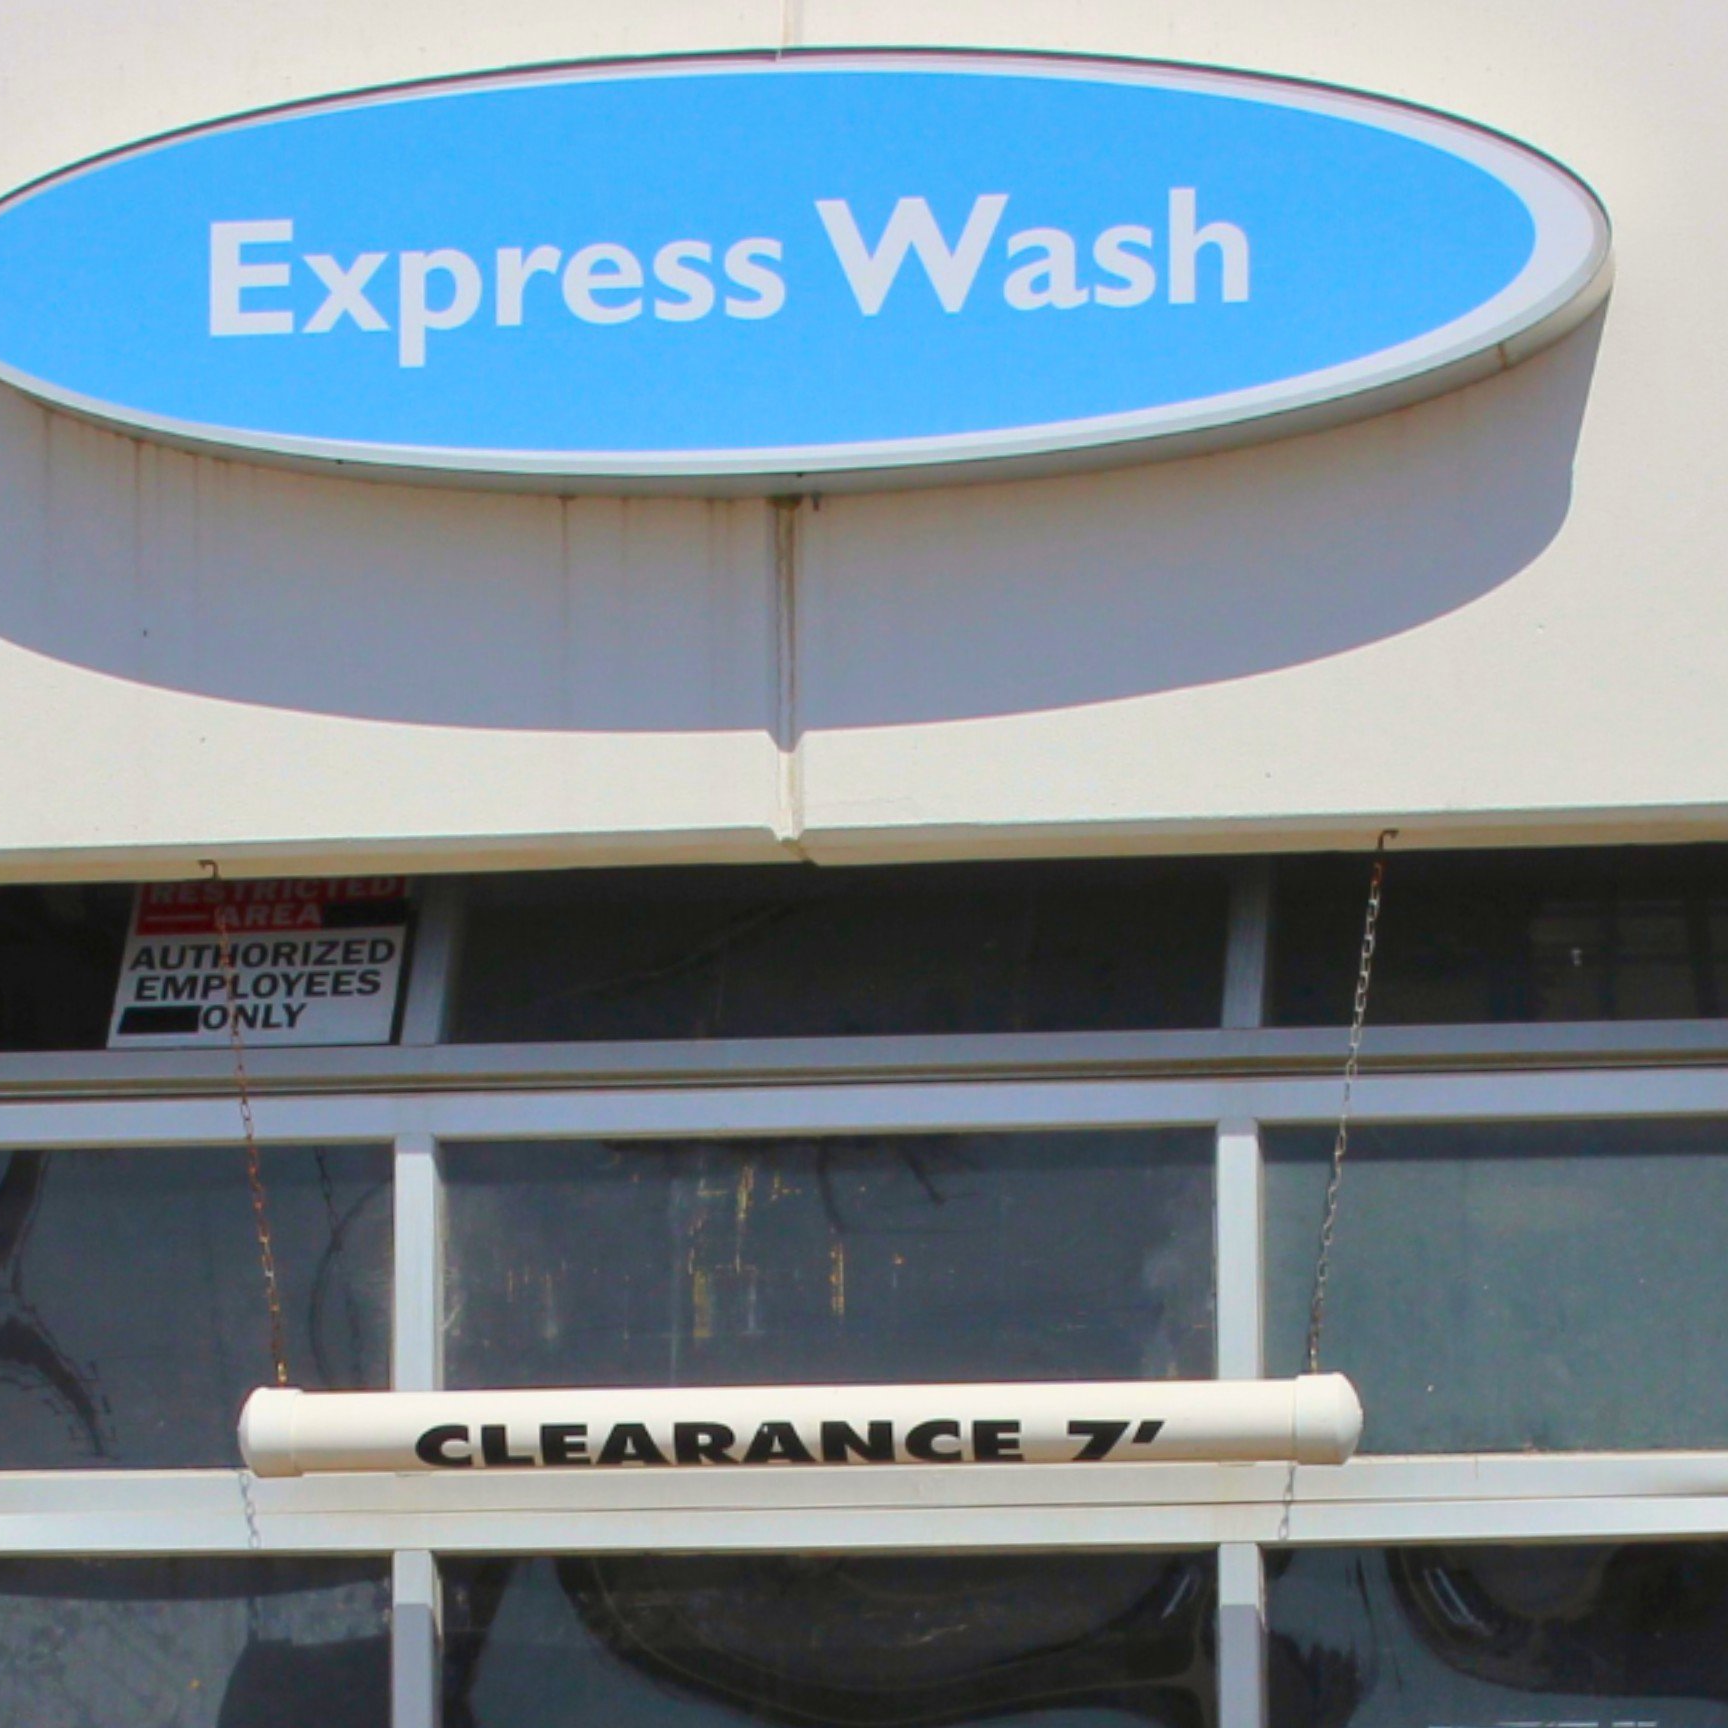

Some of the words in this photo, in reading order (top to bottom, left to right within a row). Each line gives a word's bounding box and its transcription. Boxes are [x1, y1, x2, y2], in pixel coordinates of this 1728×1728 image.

[209, 219, 786, 368] Express
[814, 187, 1250, 317] Wash
[150, 876, 398, 905] RESTRICTED
[218, 902, 322, 928] AREA
[129, 938, 396, 970] AUTHORIZED
[134, 970, 382, 1001] EMPLOYEES
[201, 1003, 307, 1030] ONLY
[414, 1420, 1021, 1467] CLEARANCE
[1067, 1420, 1166, 1462] 7'
